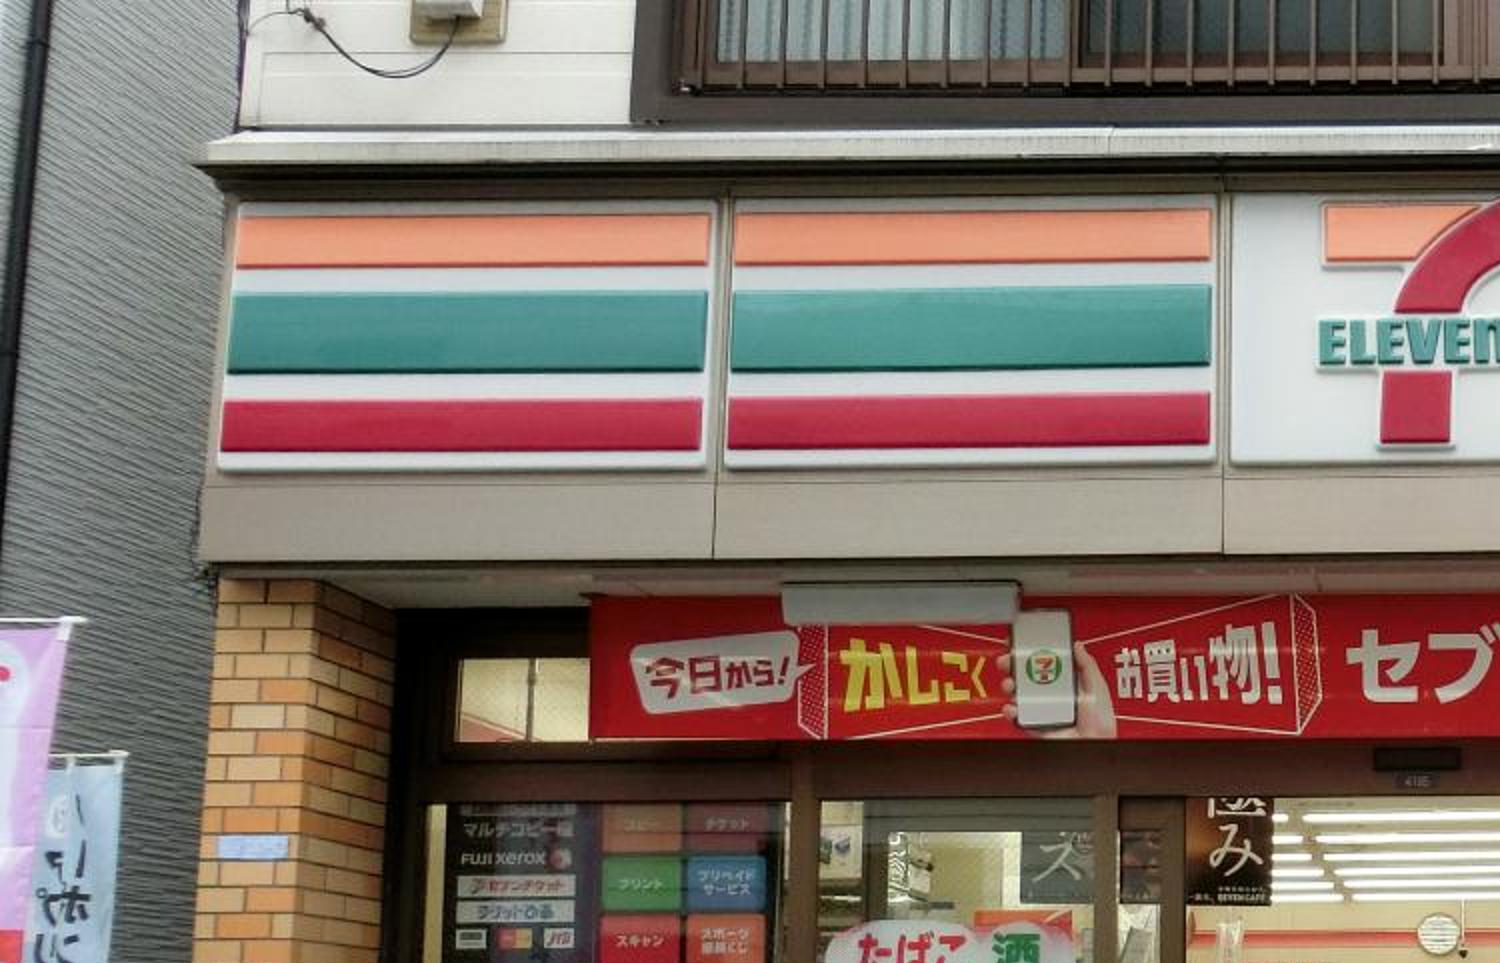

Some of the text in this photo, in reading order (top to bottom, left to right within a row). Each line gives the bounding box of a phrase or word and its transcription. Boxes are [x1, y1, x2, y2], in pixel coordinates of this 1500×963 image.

[840, 638, 988, 712] かしこく
[461, 852, 493, 865] FUJI
[618, 877, 664, 890] プリント
[702, 883, 752, 896] サービス
[615, 933, 665, 948] スキャン
